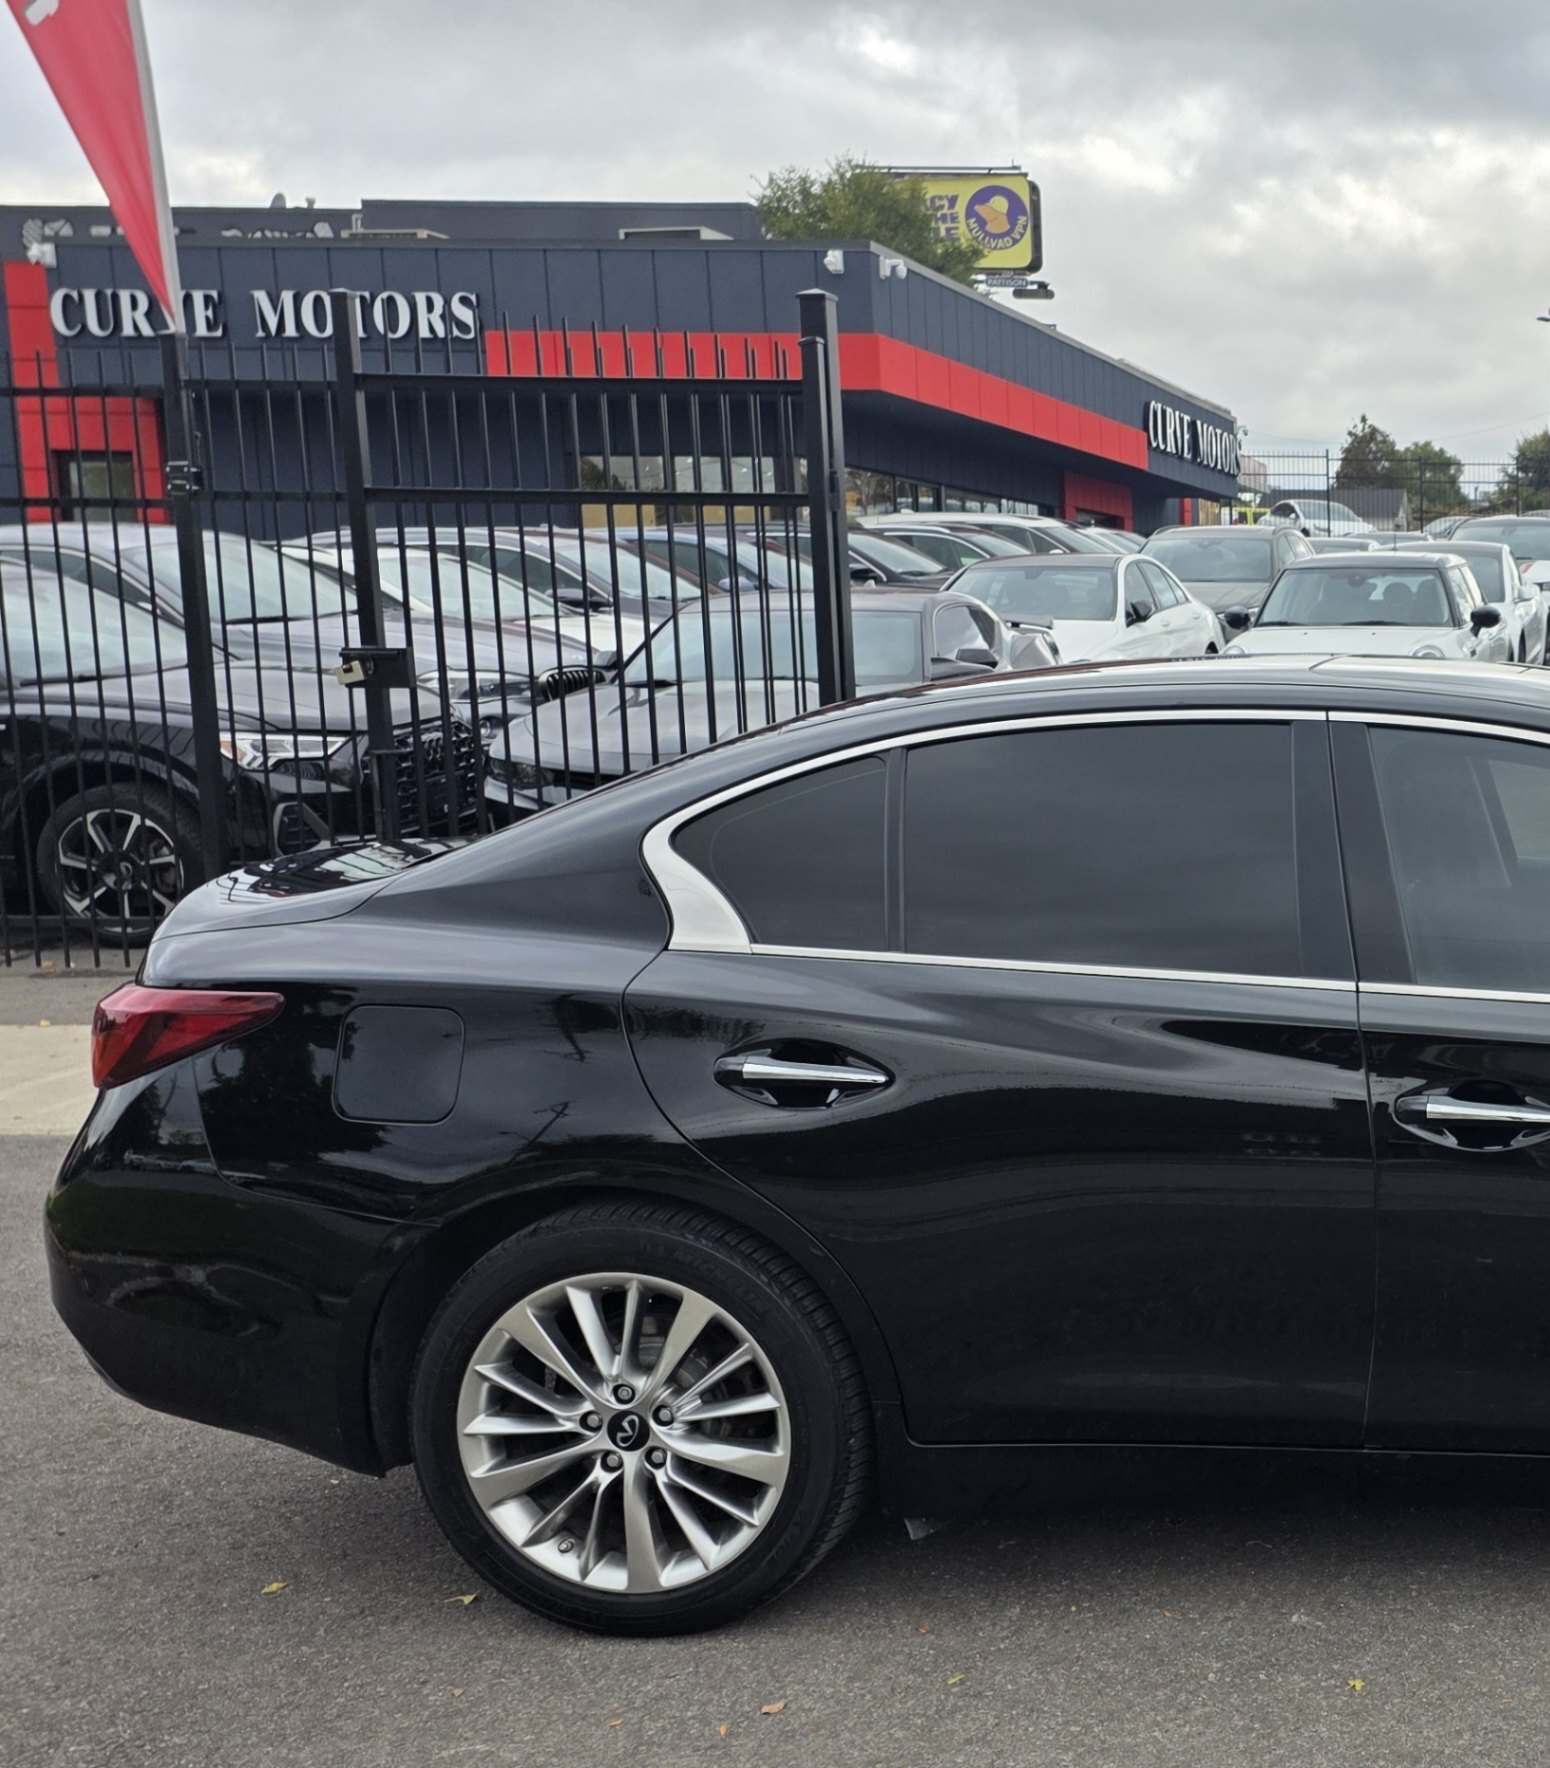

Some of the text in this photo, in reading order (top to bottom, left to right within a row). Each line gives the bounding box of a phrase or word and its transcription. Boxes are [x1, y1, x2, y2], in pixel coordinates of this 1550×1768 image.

[967, 215, 1028, 250] MULLVAD VPN
[1149, 400, 1243, 480] CURVE MOTORS
